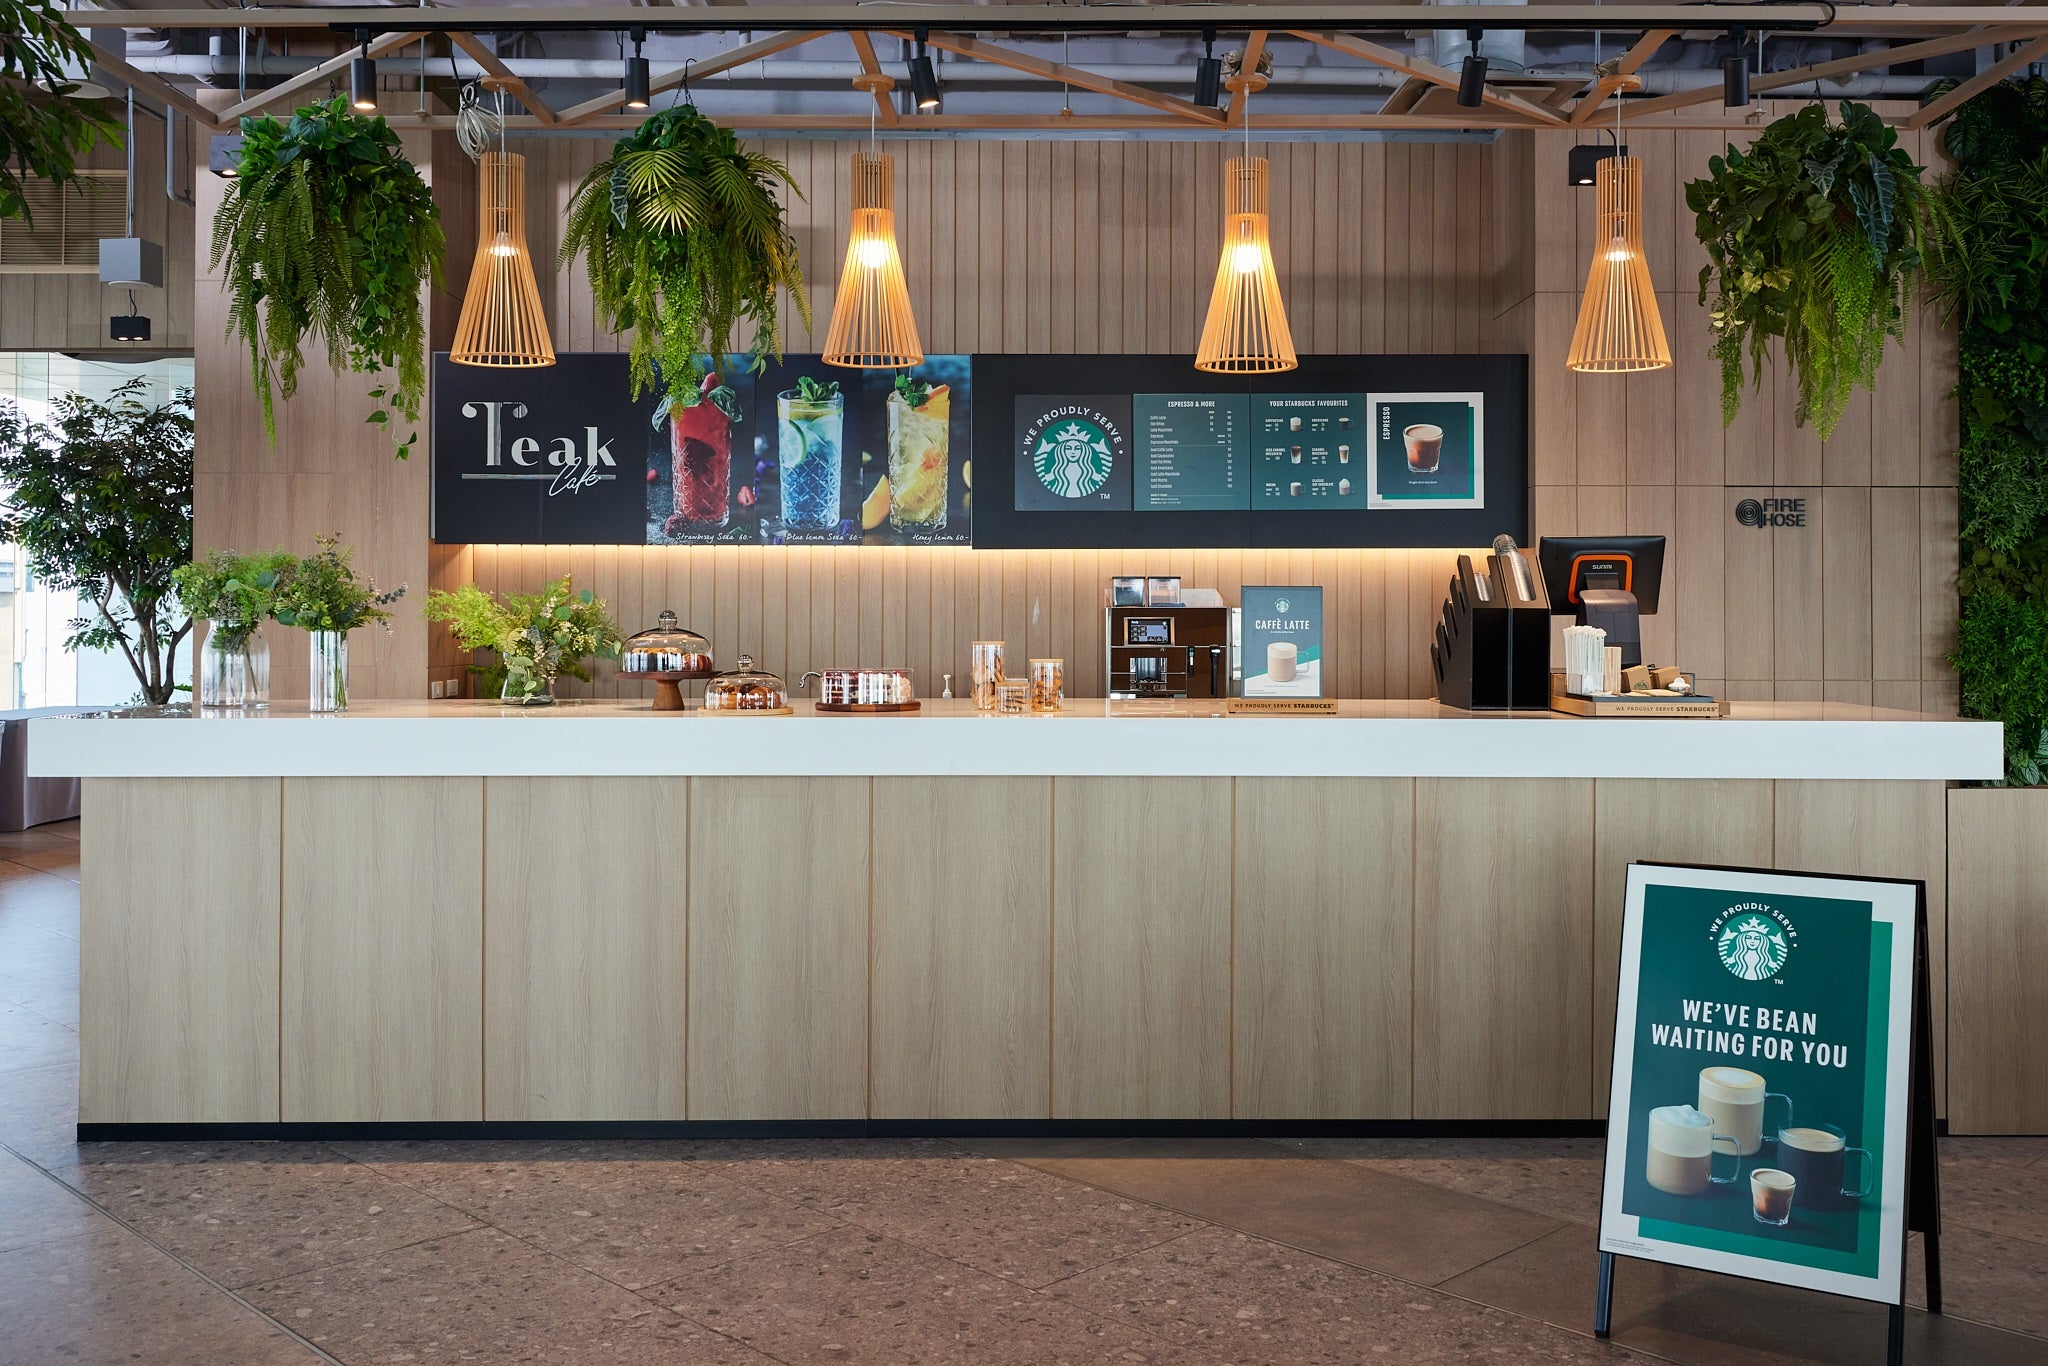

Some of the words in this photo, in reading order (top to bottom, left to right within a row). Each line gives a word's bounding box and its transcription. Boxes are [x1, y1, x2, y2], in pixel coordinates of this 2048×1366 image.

[462, 402, 617, 467] Teak
[1023, 428, 1038, 446] WE
[1036, 406, 1091, 428] PROUDLY
[1093, 412, 1123, 444] SERVE
[1382, 406, 1391, 440] ESPRESSO
[1763, 499, 1806, 512] FIRE
[1763, 514, 1806, 527] HOSE
[676, 533, 715, 544] Strawberry
[717, 533, 735, 541] Soda
[912, 533, 933, 545] Honey
[1255, 618, 1282, 630] CAFFÈ
[1284, 620, 1311, 630] LATTE
[1709, 918, 1724, 933] WE
[1722, 903, 1771, 919] PROUDLY
[1772, 910, 1797, 938] SERVE
[1682, 999, 1750, 1028] WE’VE
[1756, 1007, 1817, 1036] BEAN
[1651, 1023, 1745, 1056] WAITING
[1752, 1035, 1794, 1062] FOR
[1801, 1041, 1848, 1069] YOU
